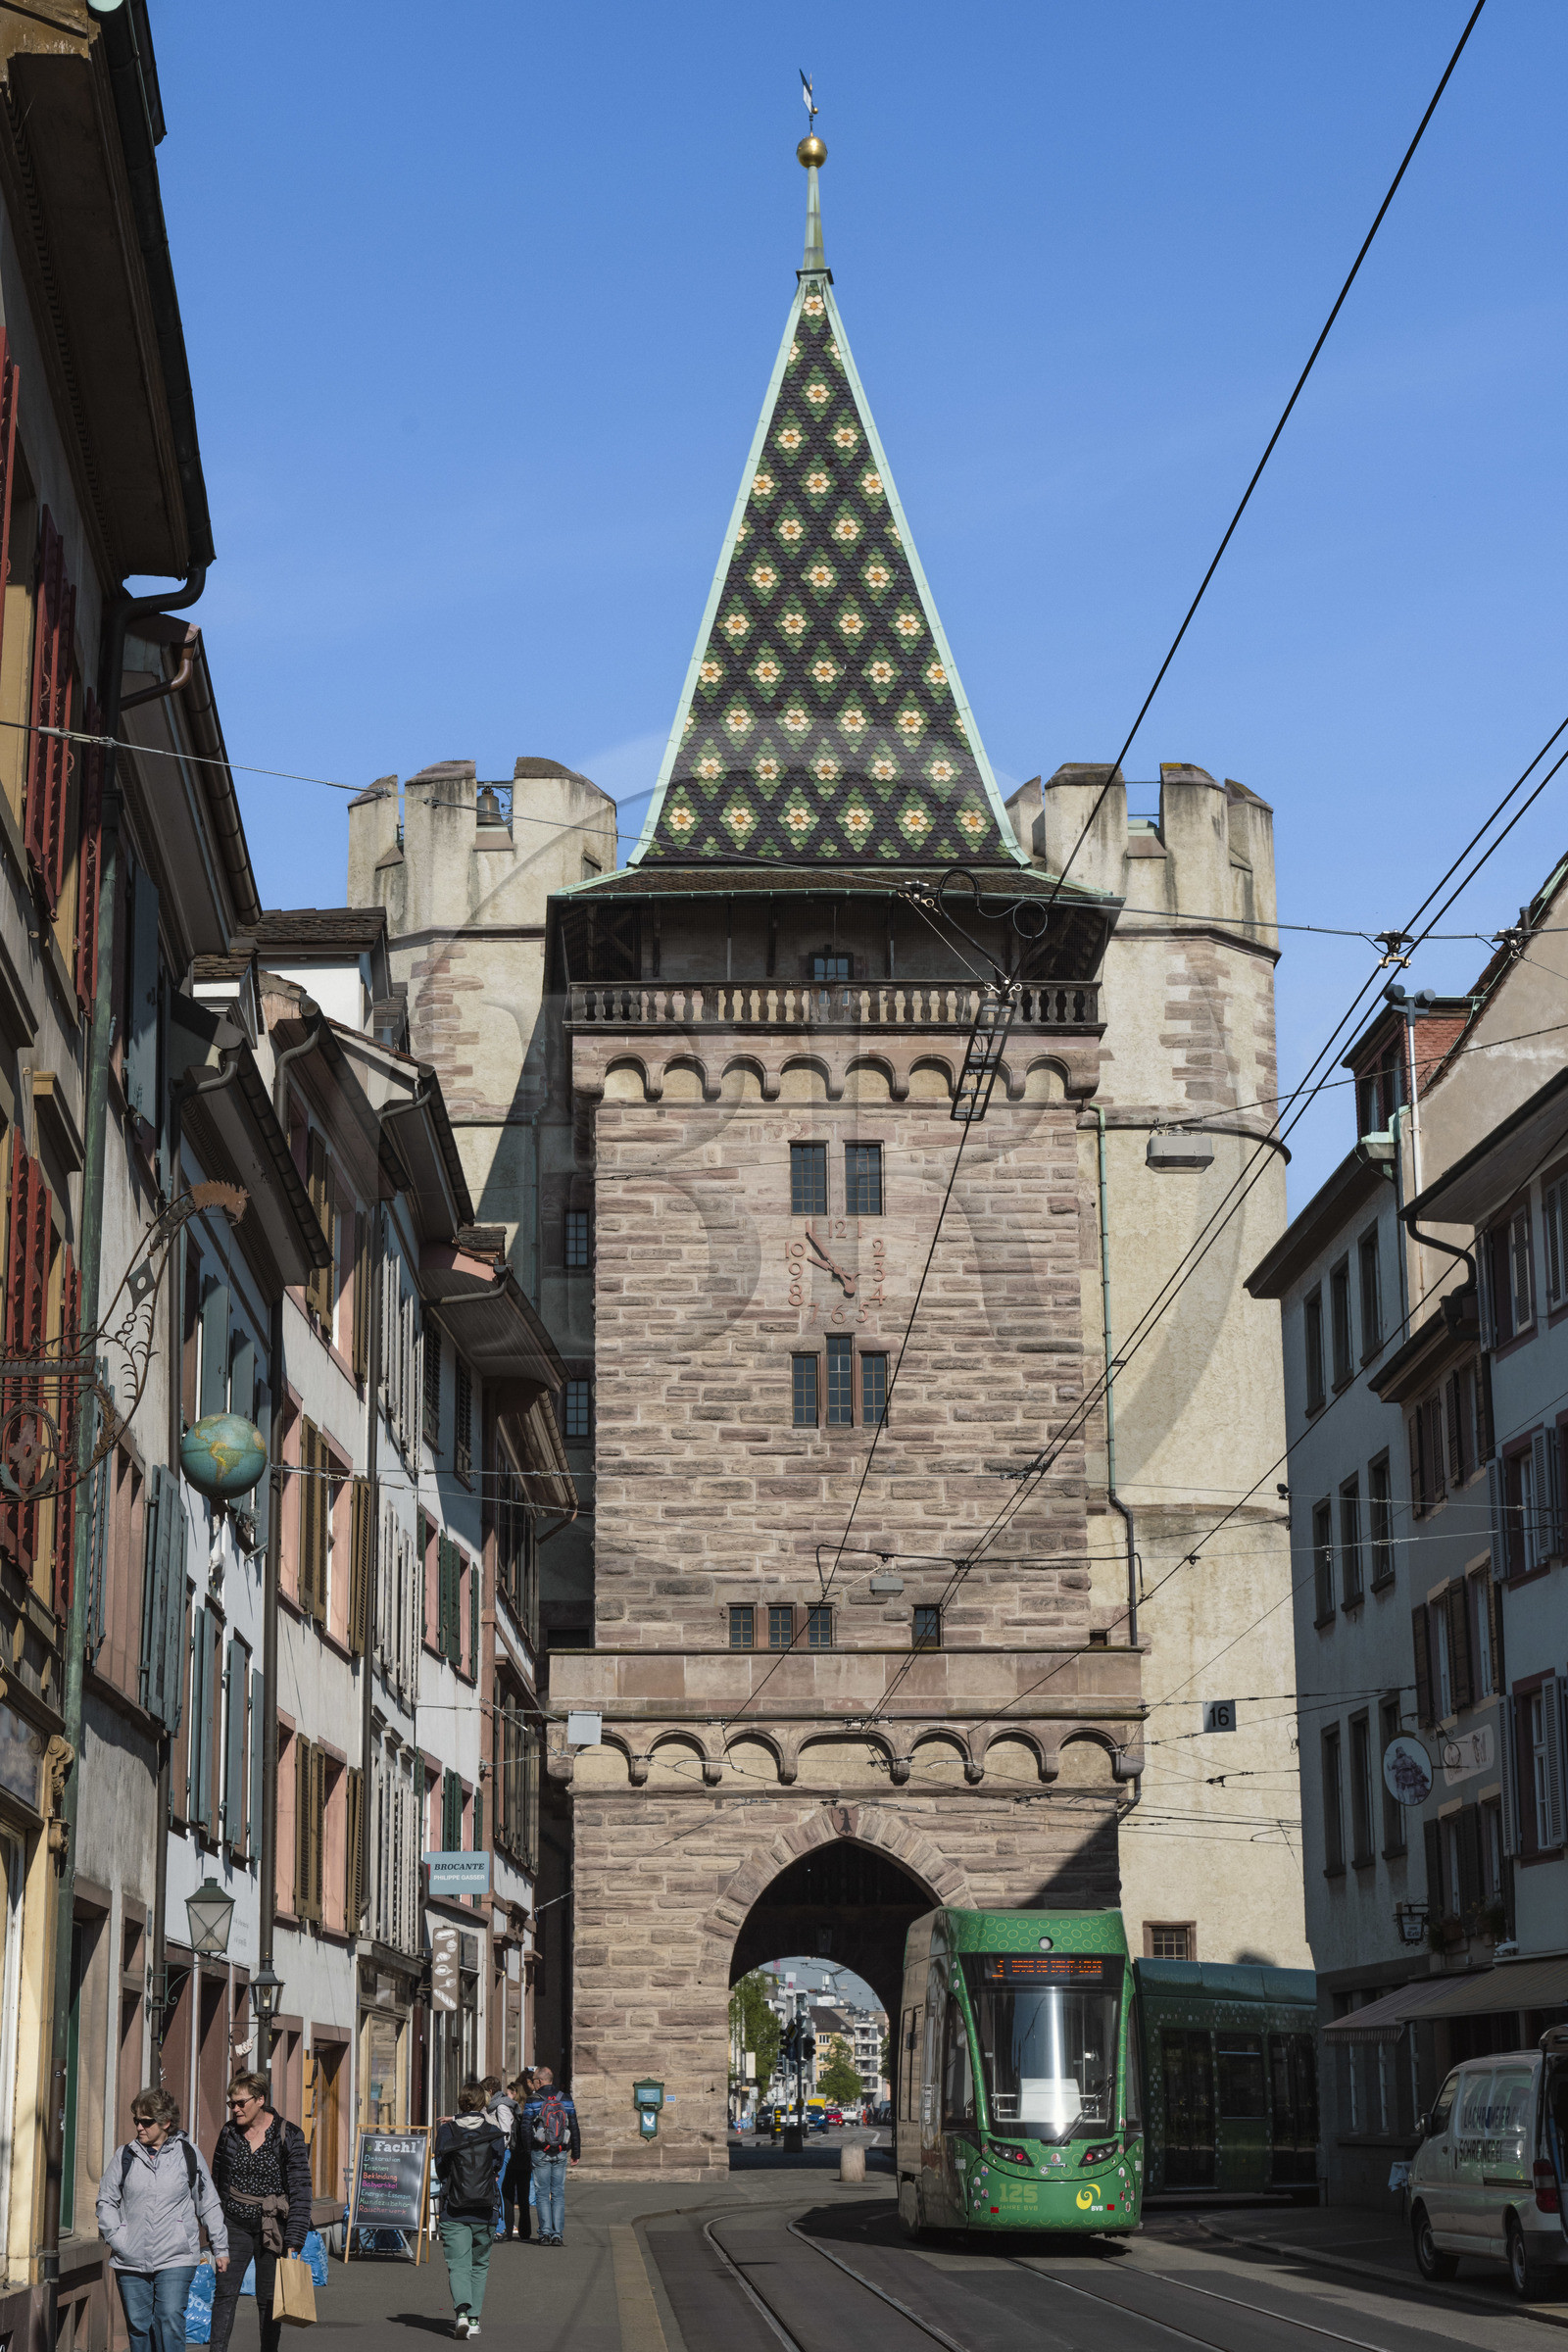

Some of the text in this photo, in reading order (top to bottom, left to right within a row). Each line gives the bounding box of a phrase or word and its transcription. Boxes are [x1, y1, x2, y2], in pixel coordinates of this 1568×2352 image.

[827, 1219, 847, 1239] 12
[857, 1219, 862, 1239] 1
[784, 1241, 807, 1258] 10
[872, 1238, 886, 1257] 2
[788, 1261, 804, 1282] 9
[872, 1259, 886, 1282] 3
[788, 1283, 805, 1306] 8
[869, 1284, 887, 1306] 4
[808, 1302, 819, 1324] 7
[831, 1303, 846, 1324] 6
[856, 1301, 869, 1323] 5
[1209, 1705, 1229, 1728] 16
[373, 2140, 416, 2153] Fachl
[1459, 2139, 1502, 2163] SCHREINEREI
[363, 2163, 389, 2172] Taschen
[363, 2172, 398, 2182] Bekleidung
[361, 2188, 412, 2199] Energie-Essenzen
[362, 2180, 398, 2188] Babyartikel
[999, 2183, 1039, 2203] 125
